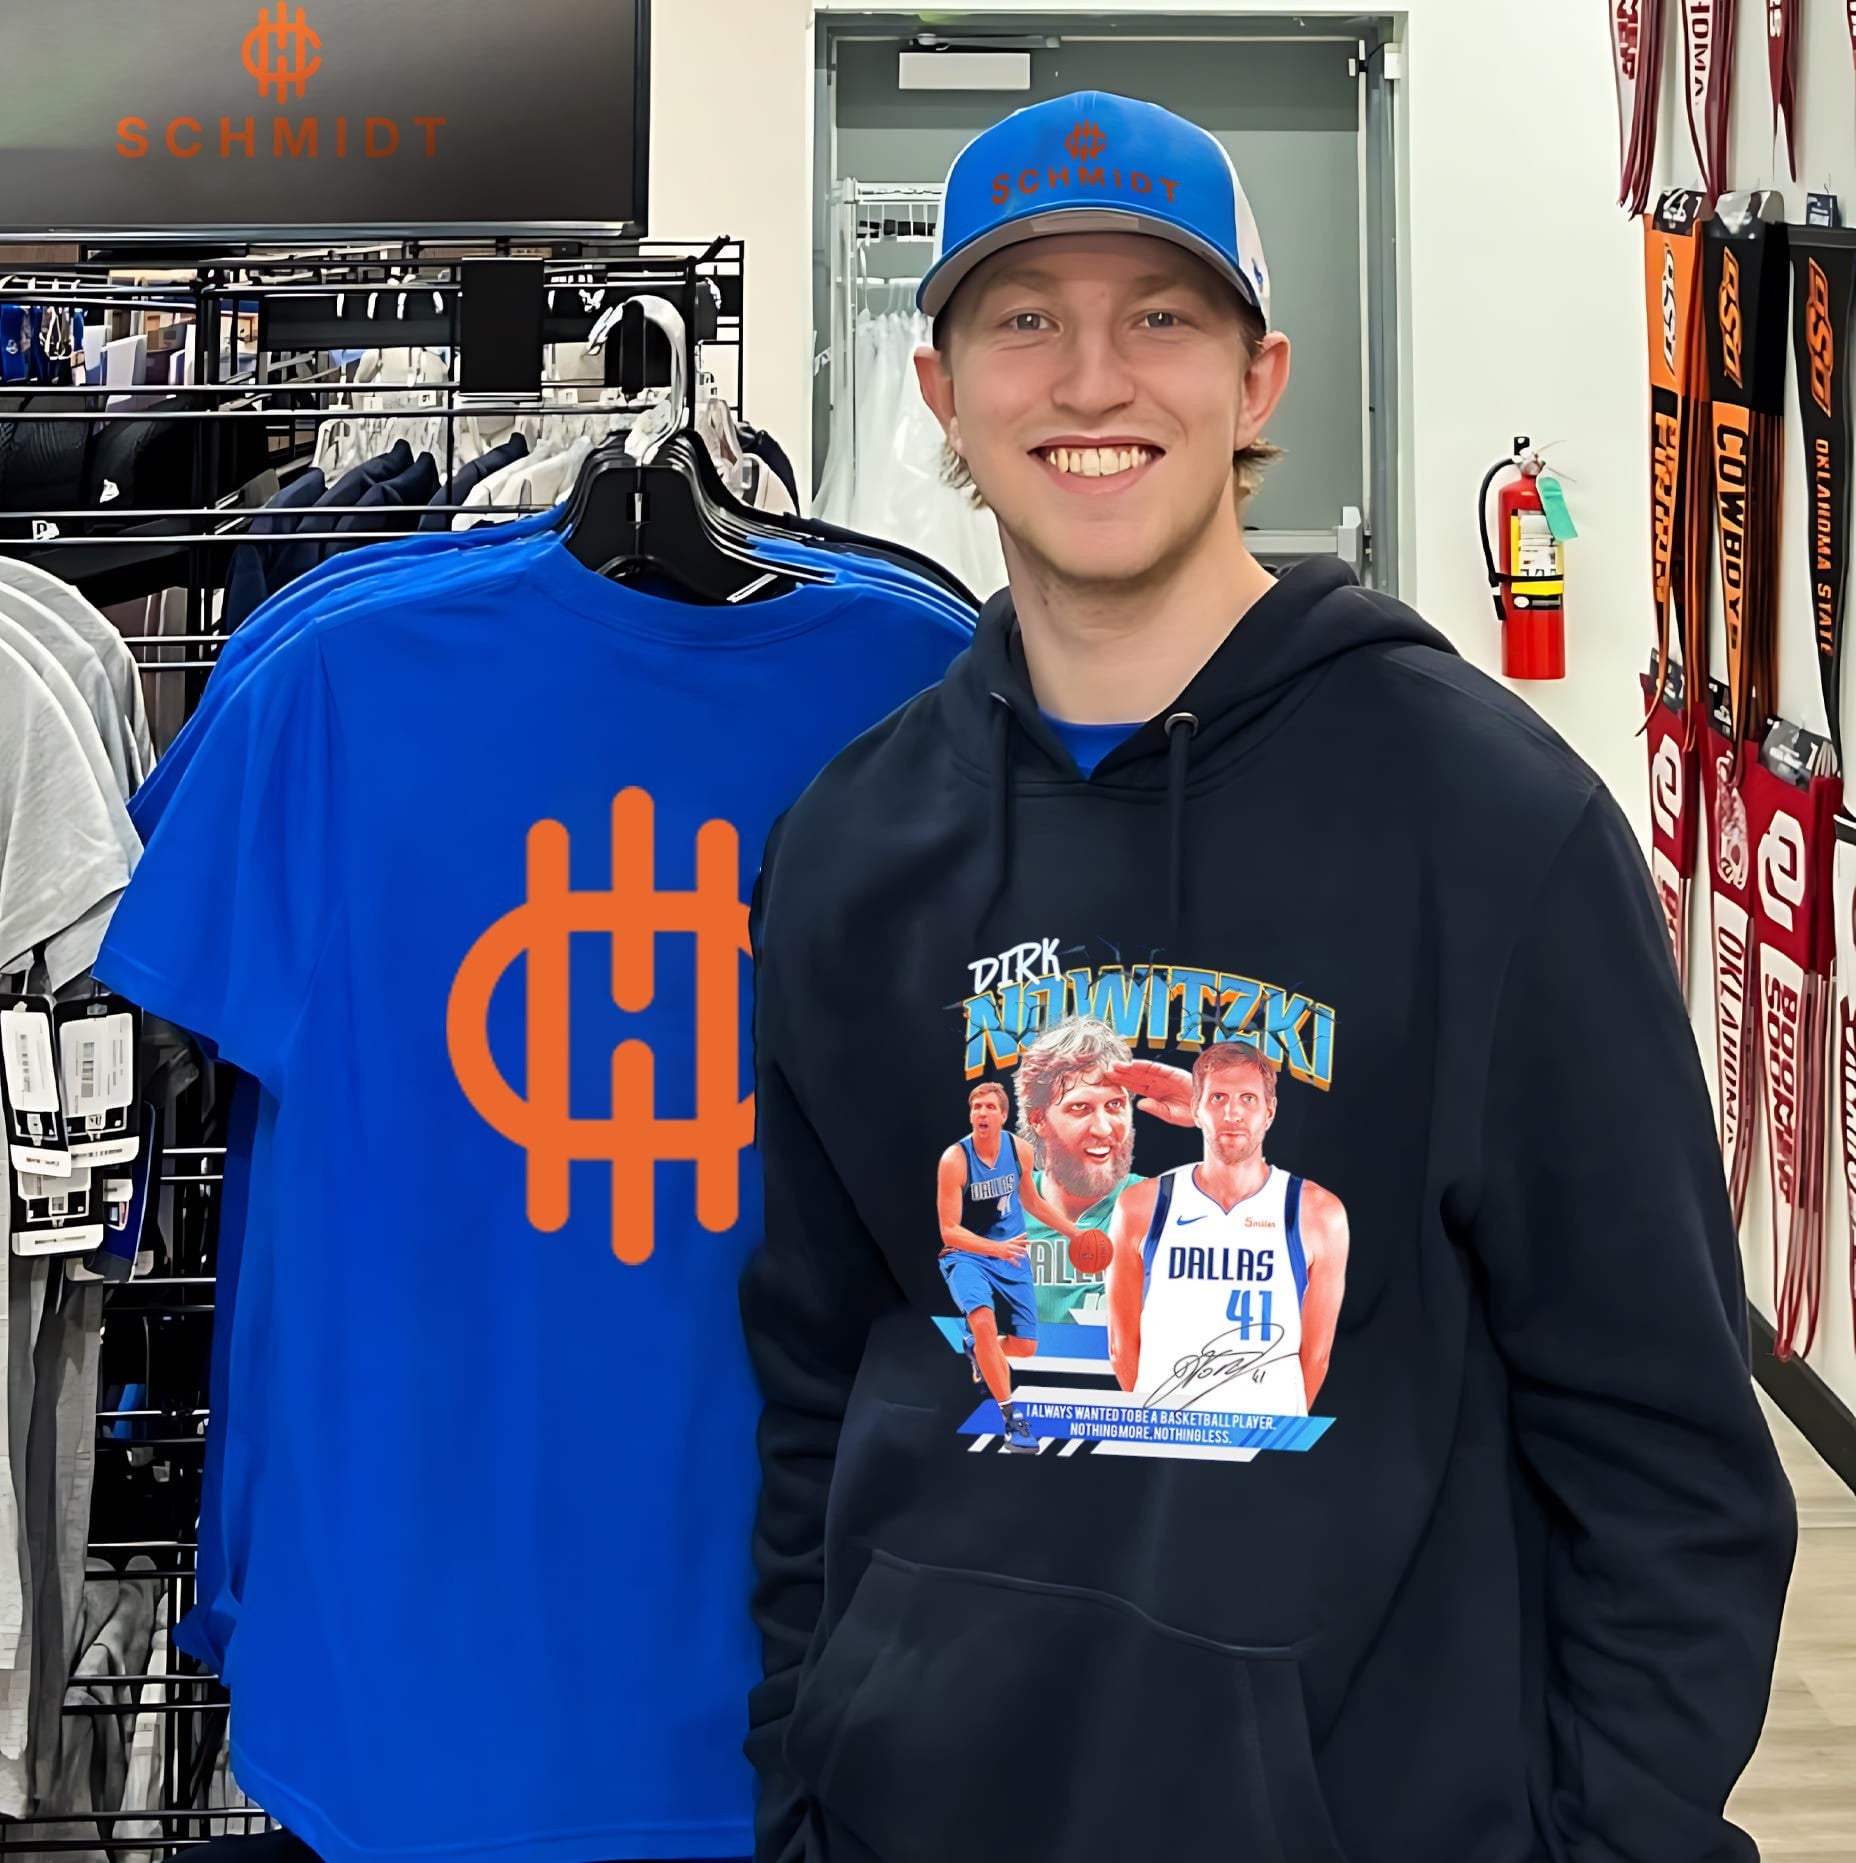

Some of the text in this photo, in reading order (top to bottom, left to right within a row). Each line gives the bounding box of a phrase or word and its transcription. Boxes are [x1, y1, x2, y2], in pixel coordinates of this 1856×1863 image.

[116, 117, 447, 158] SCHMIDT
[991, 167, 1180, 204] SCHMIDT
[1815, 438, 1833, 571] OKLAHOMA
[967, 937, 1062, 994] DIRK
[962, 964, 1337, 1092] NOWITZKI
[970, 1174, 1015, 1201] DALLAS
[1168, 1246, 1275, 1282] DALLAS
[1226, 1289, 1272, 1341] 41
[1026, 1403, 1031, 1418] I
[1031, 1403, 1074, 1420] ALWAYS
[1074, 1406, 1119, 1422] WANTED
[1150, 1410, 1158, 1424] A
[1160, 1410, 1231, 1428] BASKETBALL
[1232, 1414, 1277, 1430] PLAYER.
[1070, 1422, 1118, 1438] NOTHING
[1153, 1426, 1202, 1442] NOTHING
